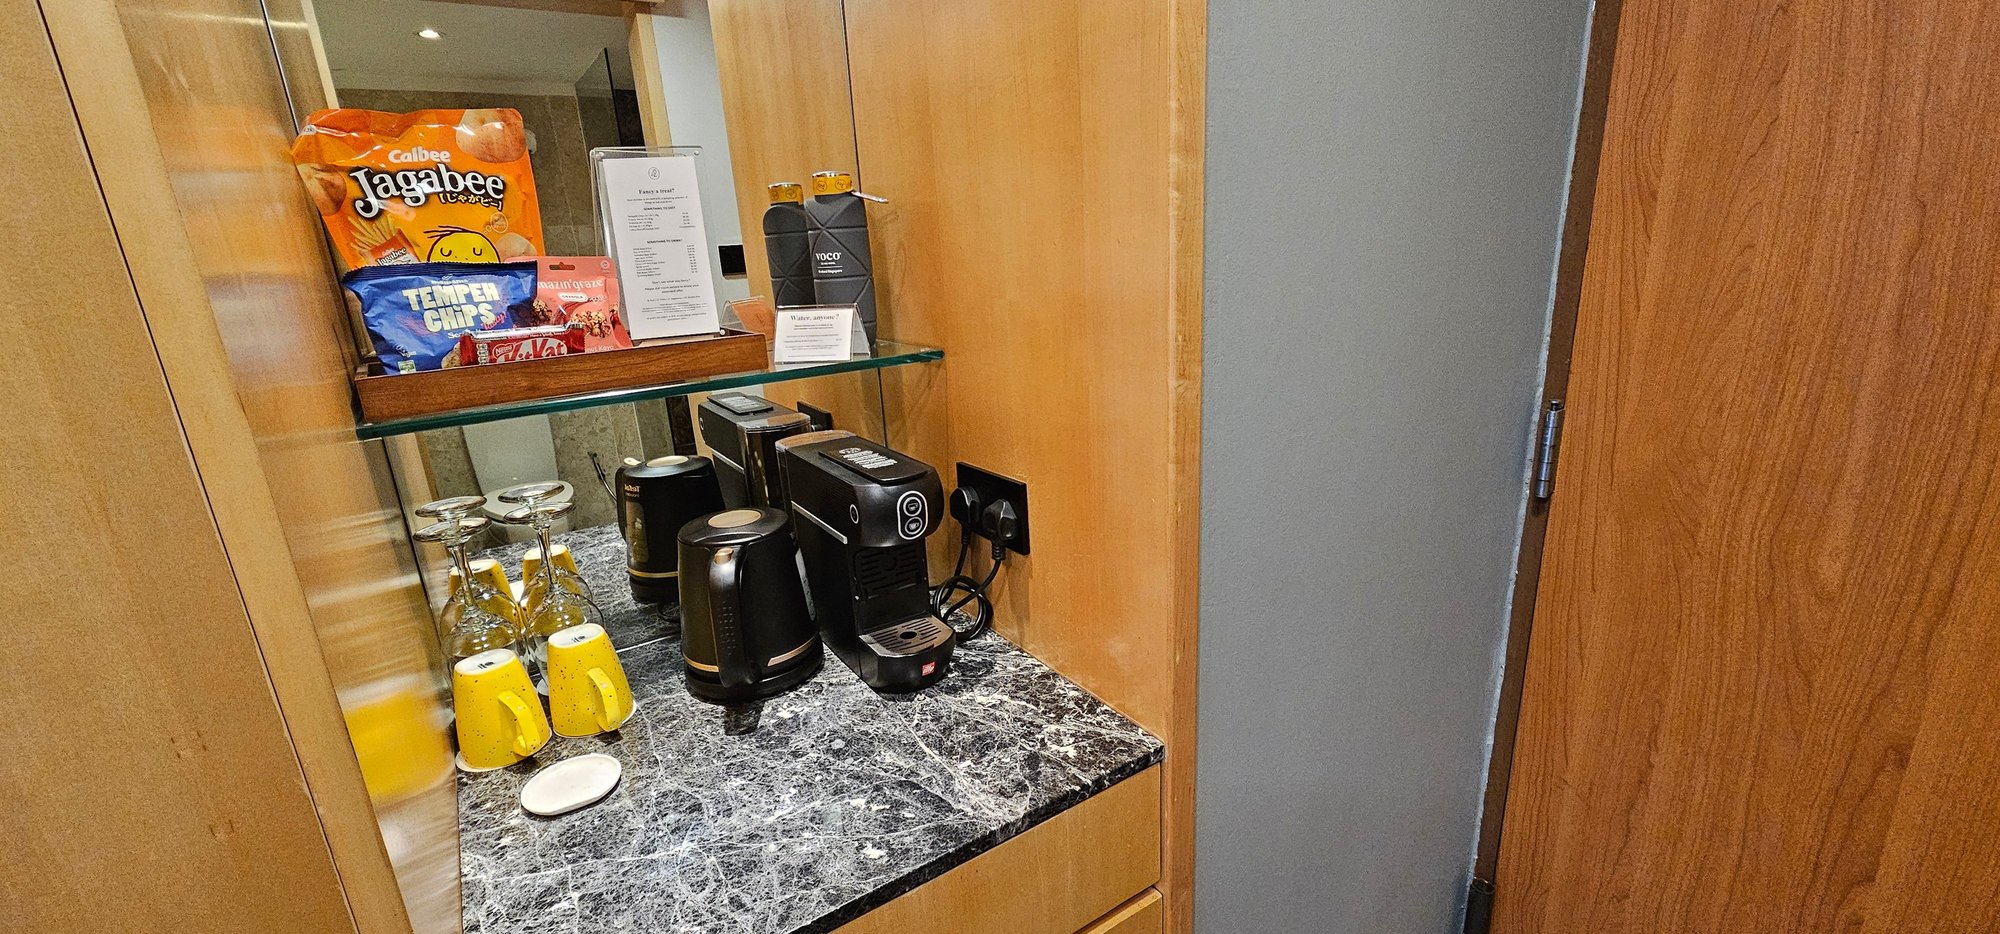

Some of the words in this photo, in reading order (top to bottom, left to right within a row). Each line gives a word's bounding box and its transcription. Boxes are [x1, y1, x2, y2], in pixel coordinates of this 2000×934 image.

[388, 147, 451, 163] Calbee
[349, 163, 504, 218] Jagabee
[538, 279, 605, 291] mazin'graze
[402, 282, 500, 311] TEMPEH
[813, 314, 839, 322] anyone?
